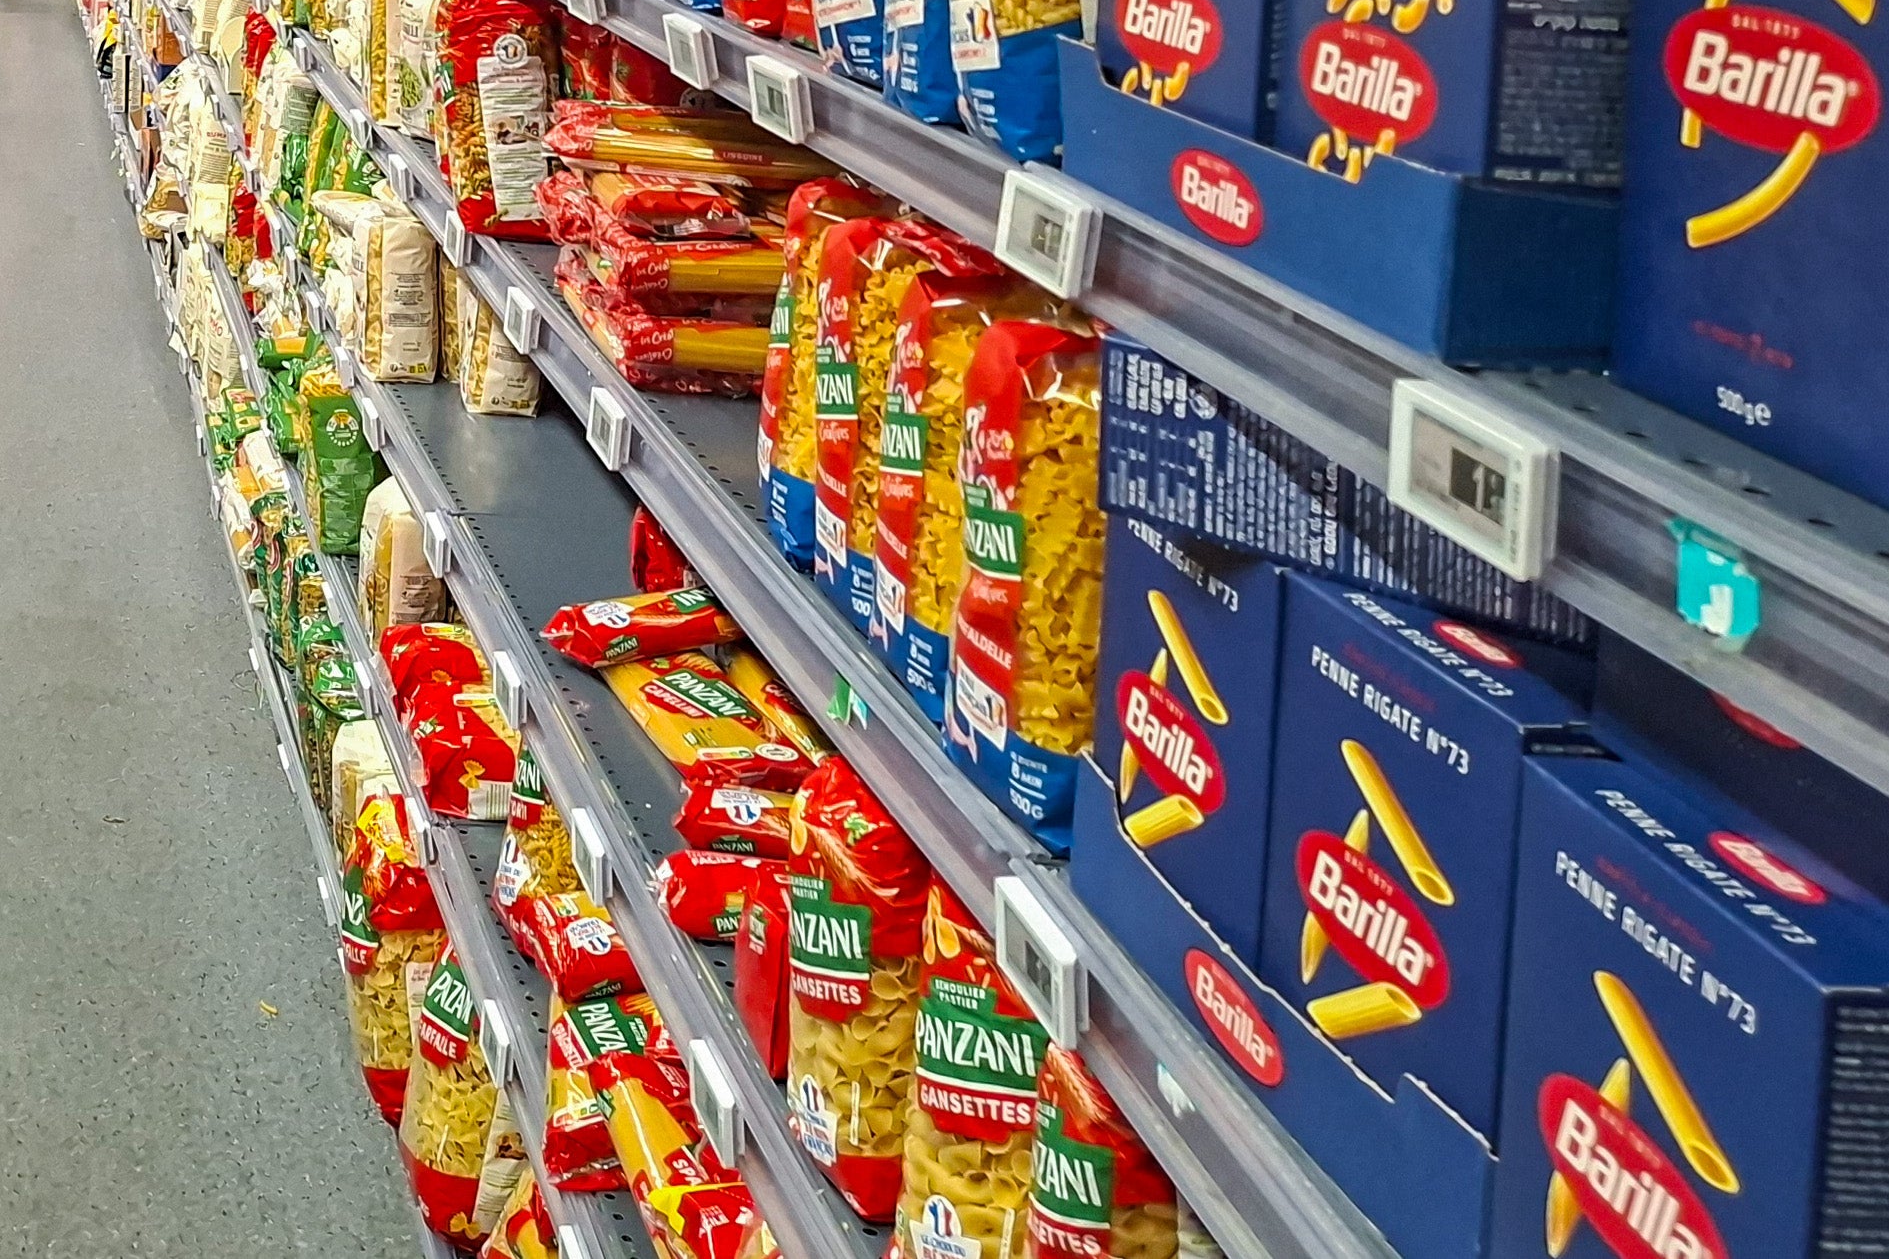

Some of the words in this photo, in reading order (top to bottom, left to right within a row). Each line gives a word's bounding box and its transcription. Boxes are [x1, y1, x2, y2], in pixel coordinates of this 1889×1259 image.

[1312, 42, 1416, 121] Barilla
[1683, 29, 1848, 128] Barilla
[1181, 165, 1251, 230] Barilla
[605, 636, 638, 659] PANZANI
[644, 684, 705, 718] CAPELLINI
[664, 671, 748, 716] PANZANI
[1311, 644, 1360, 699] PENNE
[1363, 682, 1422, 742] RIGATE
[1426, 727, 1470, 775] N°73
[1125, 685, 1208, 798] Barilla
[712, 841, 754, 853] PANZANI
[1309, 848, 1432, 987] Barilla
[1555, 850, 1618, 922] PENNE
[1621, 905, 1696, 986] RIGATE
[1700, 969, 1756, 1035] N°73
[934, 979, 987, 1000] SEMOULIER
[938, 991, 979, 1010] PASTIER
[1195, 964, 1270, 1069] Barilla
[577, 1002, 631, 1054] PANZA
[915, 1009, 1036, 1077] PANZANI
[920, 1083, 1032, 1125] GANSETTES
